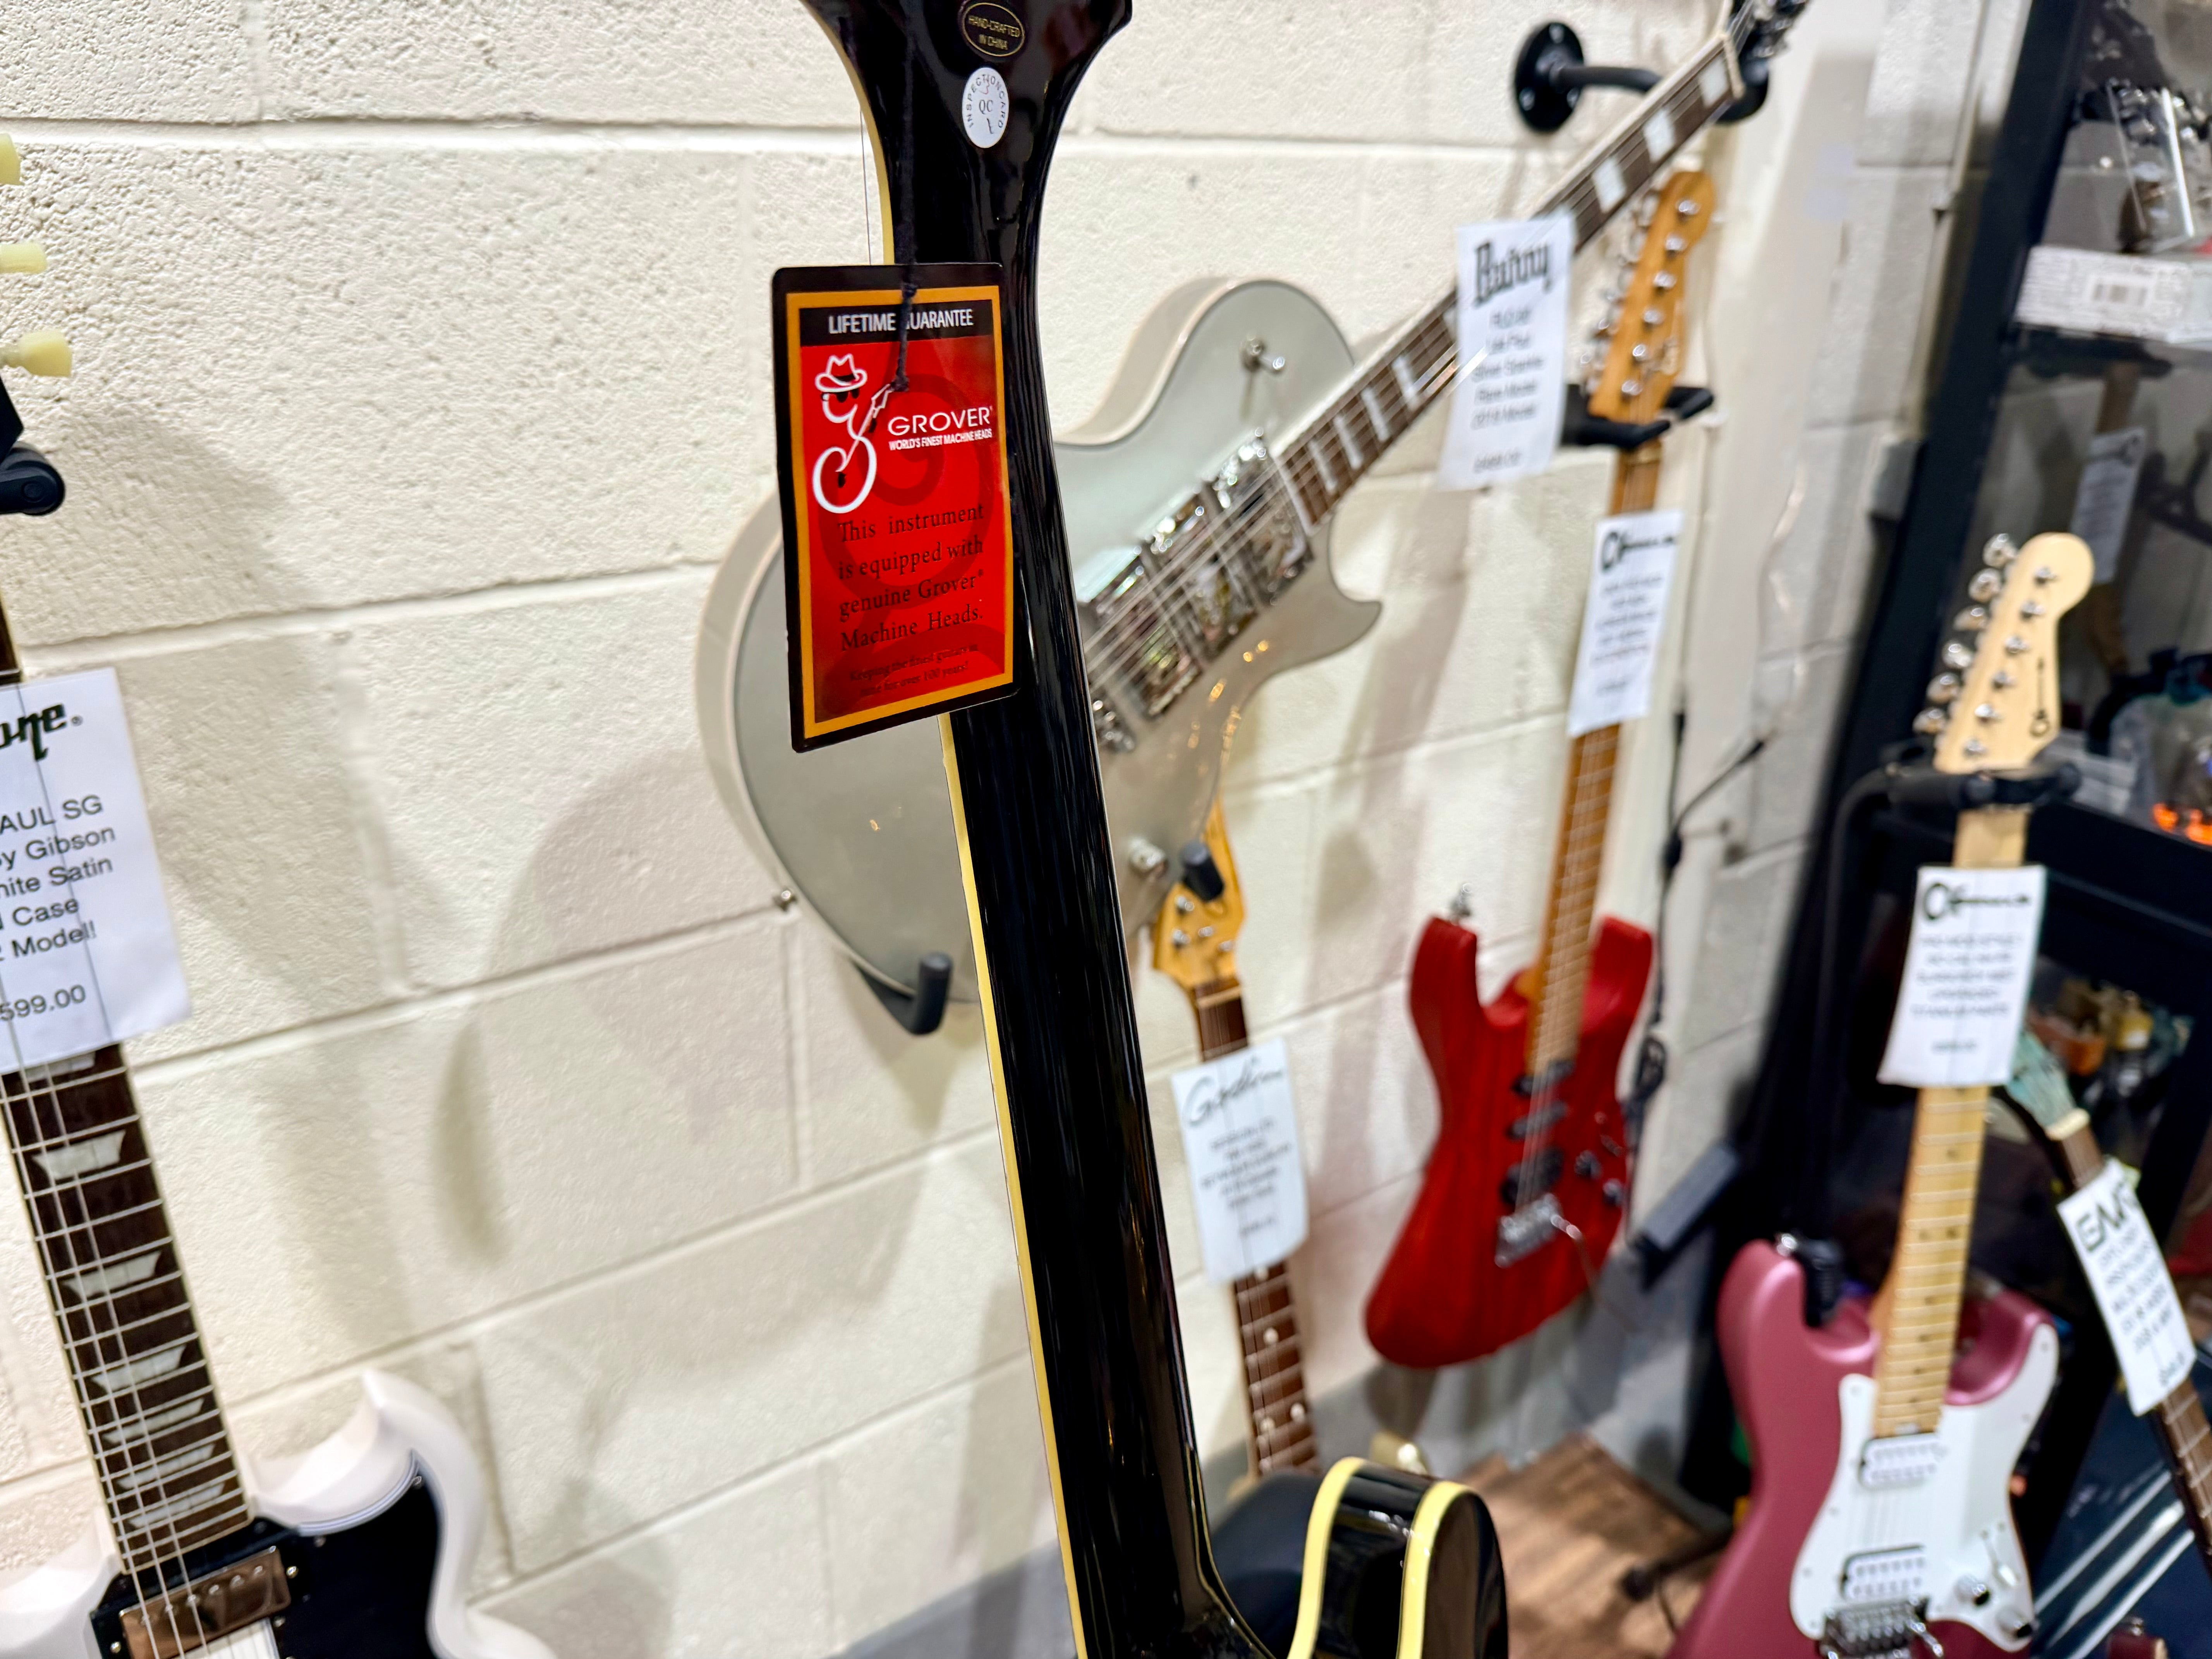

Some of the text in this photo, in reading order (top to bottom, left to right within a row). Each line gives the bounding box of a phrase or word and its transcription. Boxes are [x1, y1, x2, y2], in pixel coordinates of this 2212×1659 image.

[979, 100, 993, 115] QC
[828, 309, 974, 334] LIFETIME UARANTEE
[888, 407, 990, 436] GROVER
[888, 428, 992, 451] WORLD'S FINEST MACHINE HEADS
[838, 504, 984, 543] This instrument
[838, 534, 984, 580] is equipped with
[839, 588, 911, 623] genuine
[840, 603, 984, 652] Machine Heads.
[0, 794, 103, 835] AUL SG
[0, 826, 116, 871] y Gibson
[48, 857, 113, 886] Satin
[12, 898, 79, 926] Case
[11, 920, 98, 958] Model!
